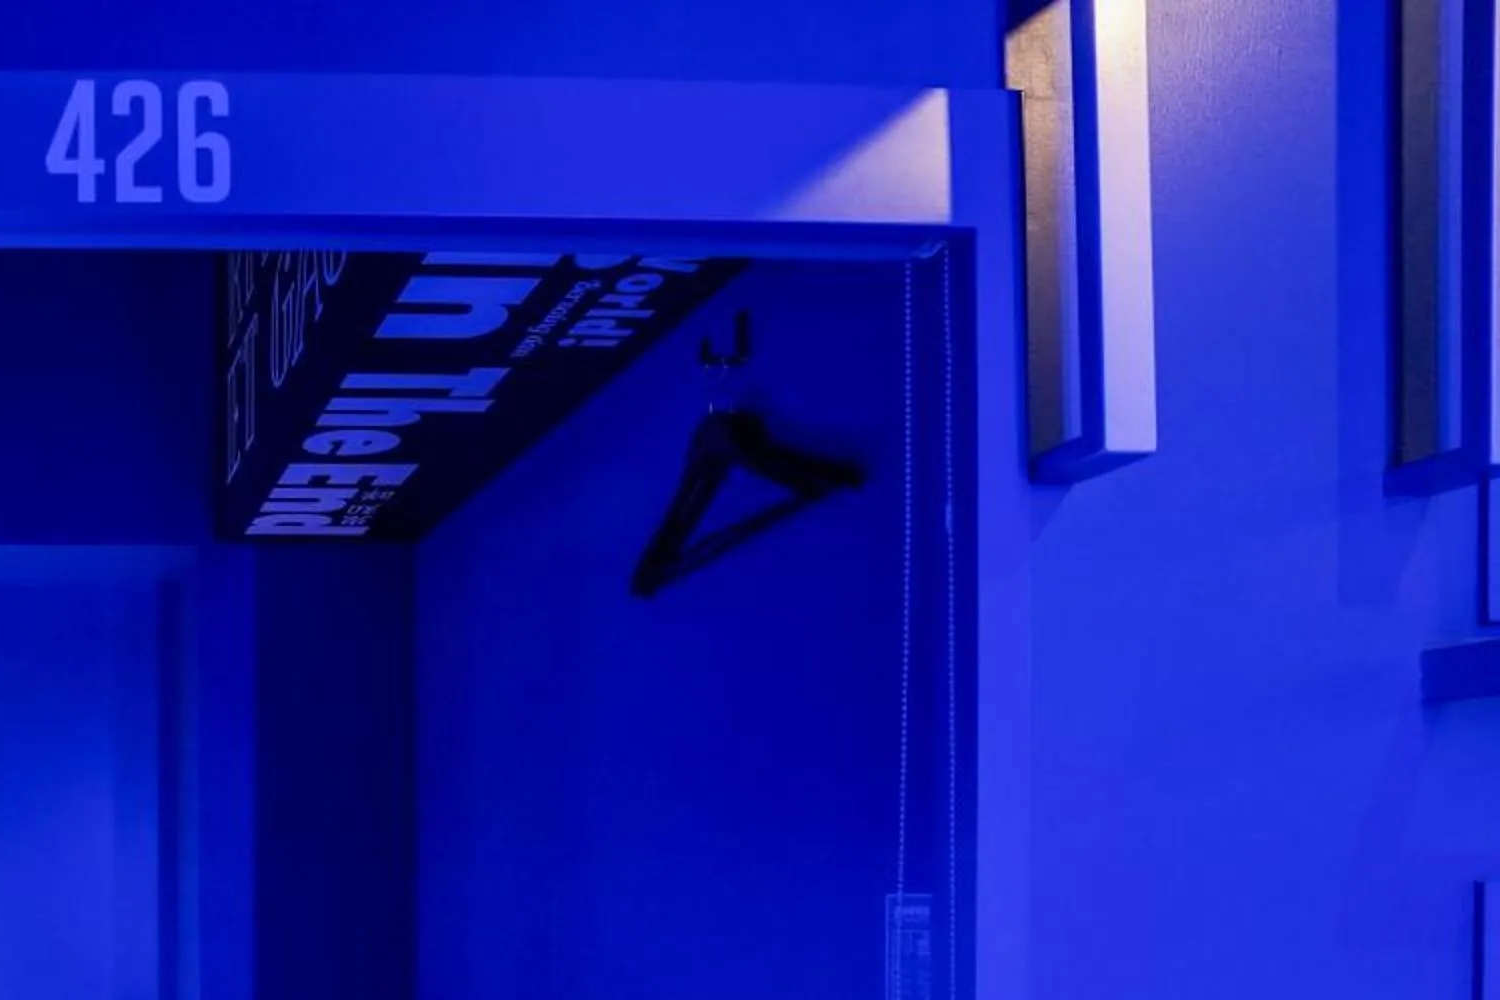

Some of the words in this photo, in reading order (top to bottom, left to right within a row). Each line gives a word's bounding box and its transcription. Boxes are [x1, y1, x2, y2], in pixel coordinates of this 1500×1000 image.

[45, 79, 231, 203] 426
[302, 367, 512, 456] The
[244, 463, 420, 537] End
